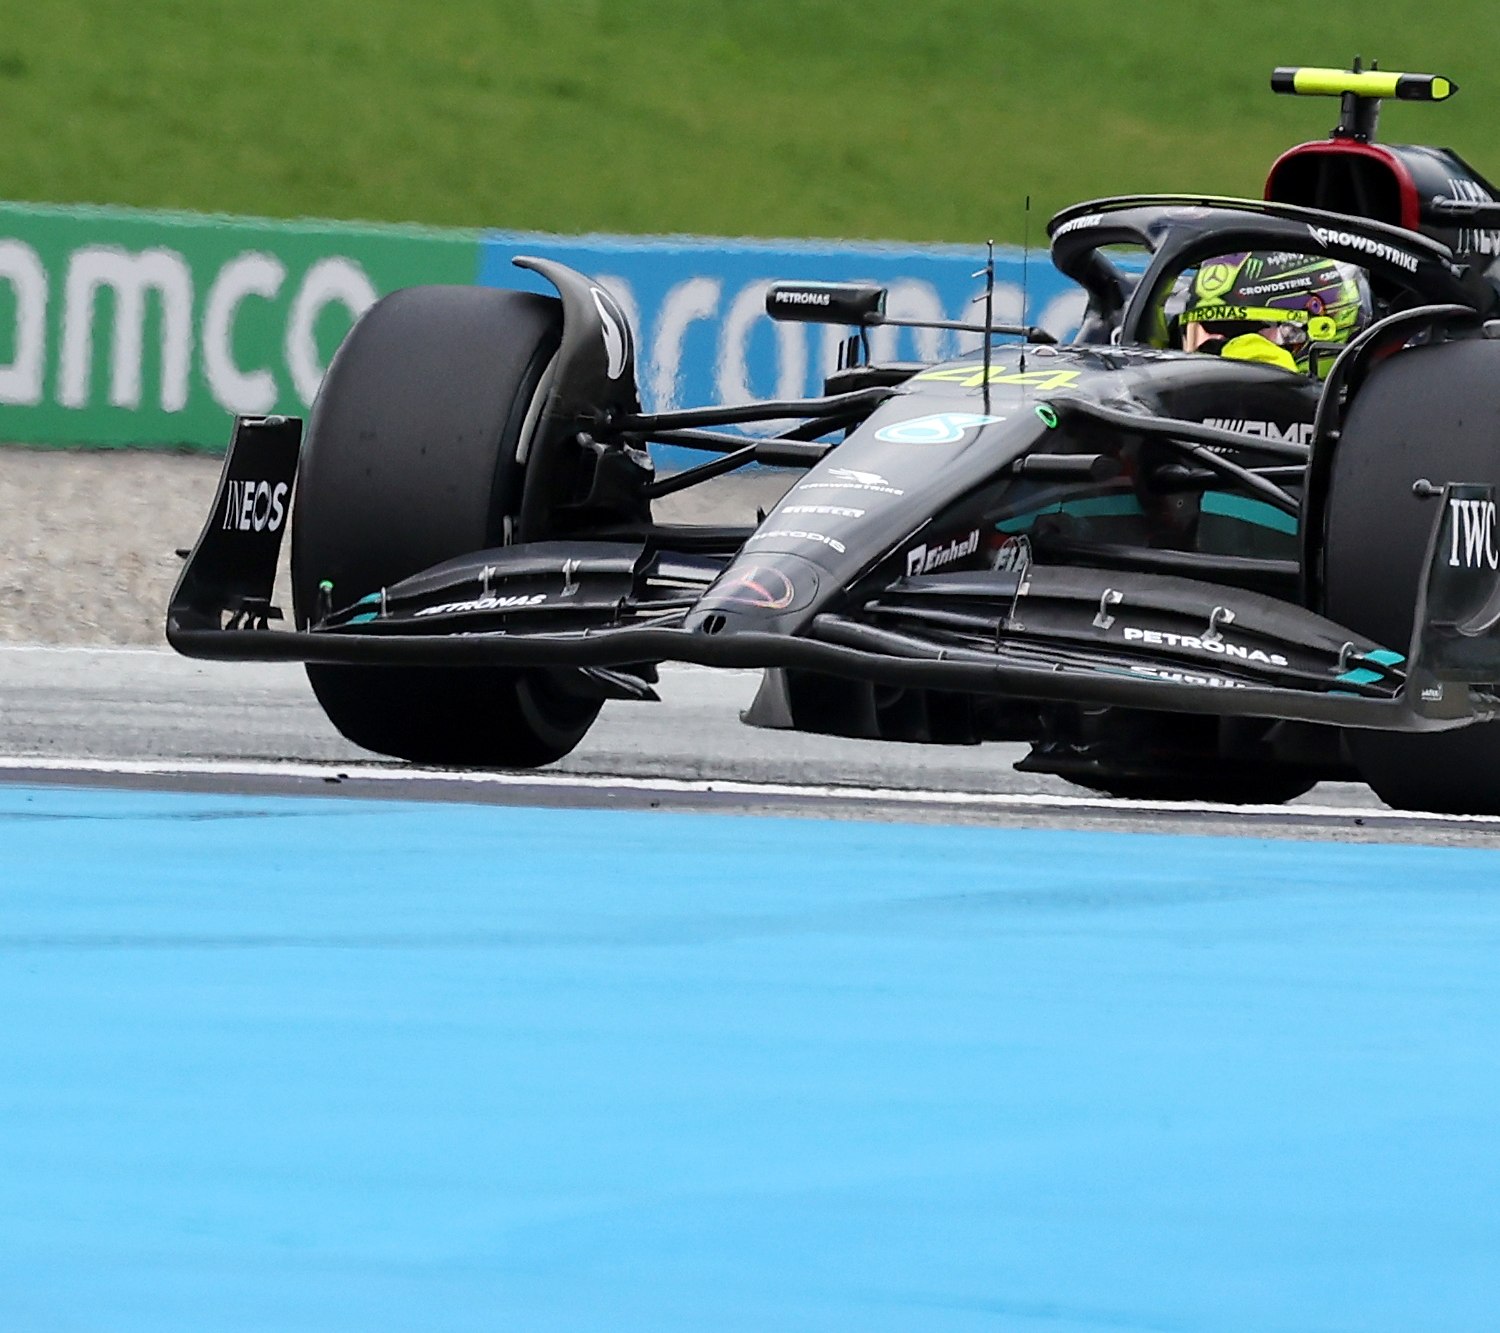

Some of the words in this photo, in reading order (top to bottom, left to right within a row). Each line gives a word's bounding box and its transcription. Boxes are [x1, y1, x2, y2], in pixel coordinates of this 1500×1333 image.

[1316, 226, 1420, 274] CROWDSTRIKE
[775, 291, 831, 306] PETRONAS
[1237, 276, 1312, 297] CROWDSTRIKE
[915, 364, 1082, 391] 44
[222, 479, 288, 532] INEOS
[924, 528, 981, 574] Einhell
[1449, 498, 1499, 570] IWC
[1124, 626, 1289, 667] PETRONAS
